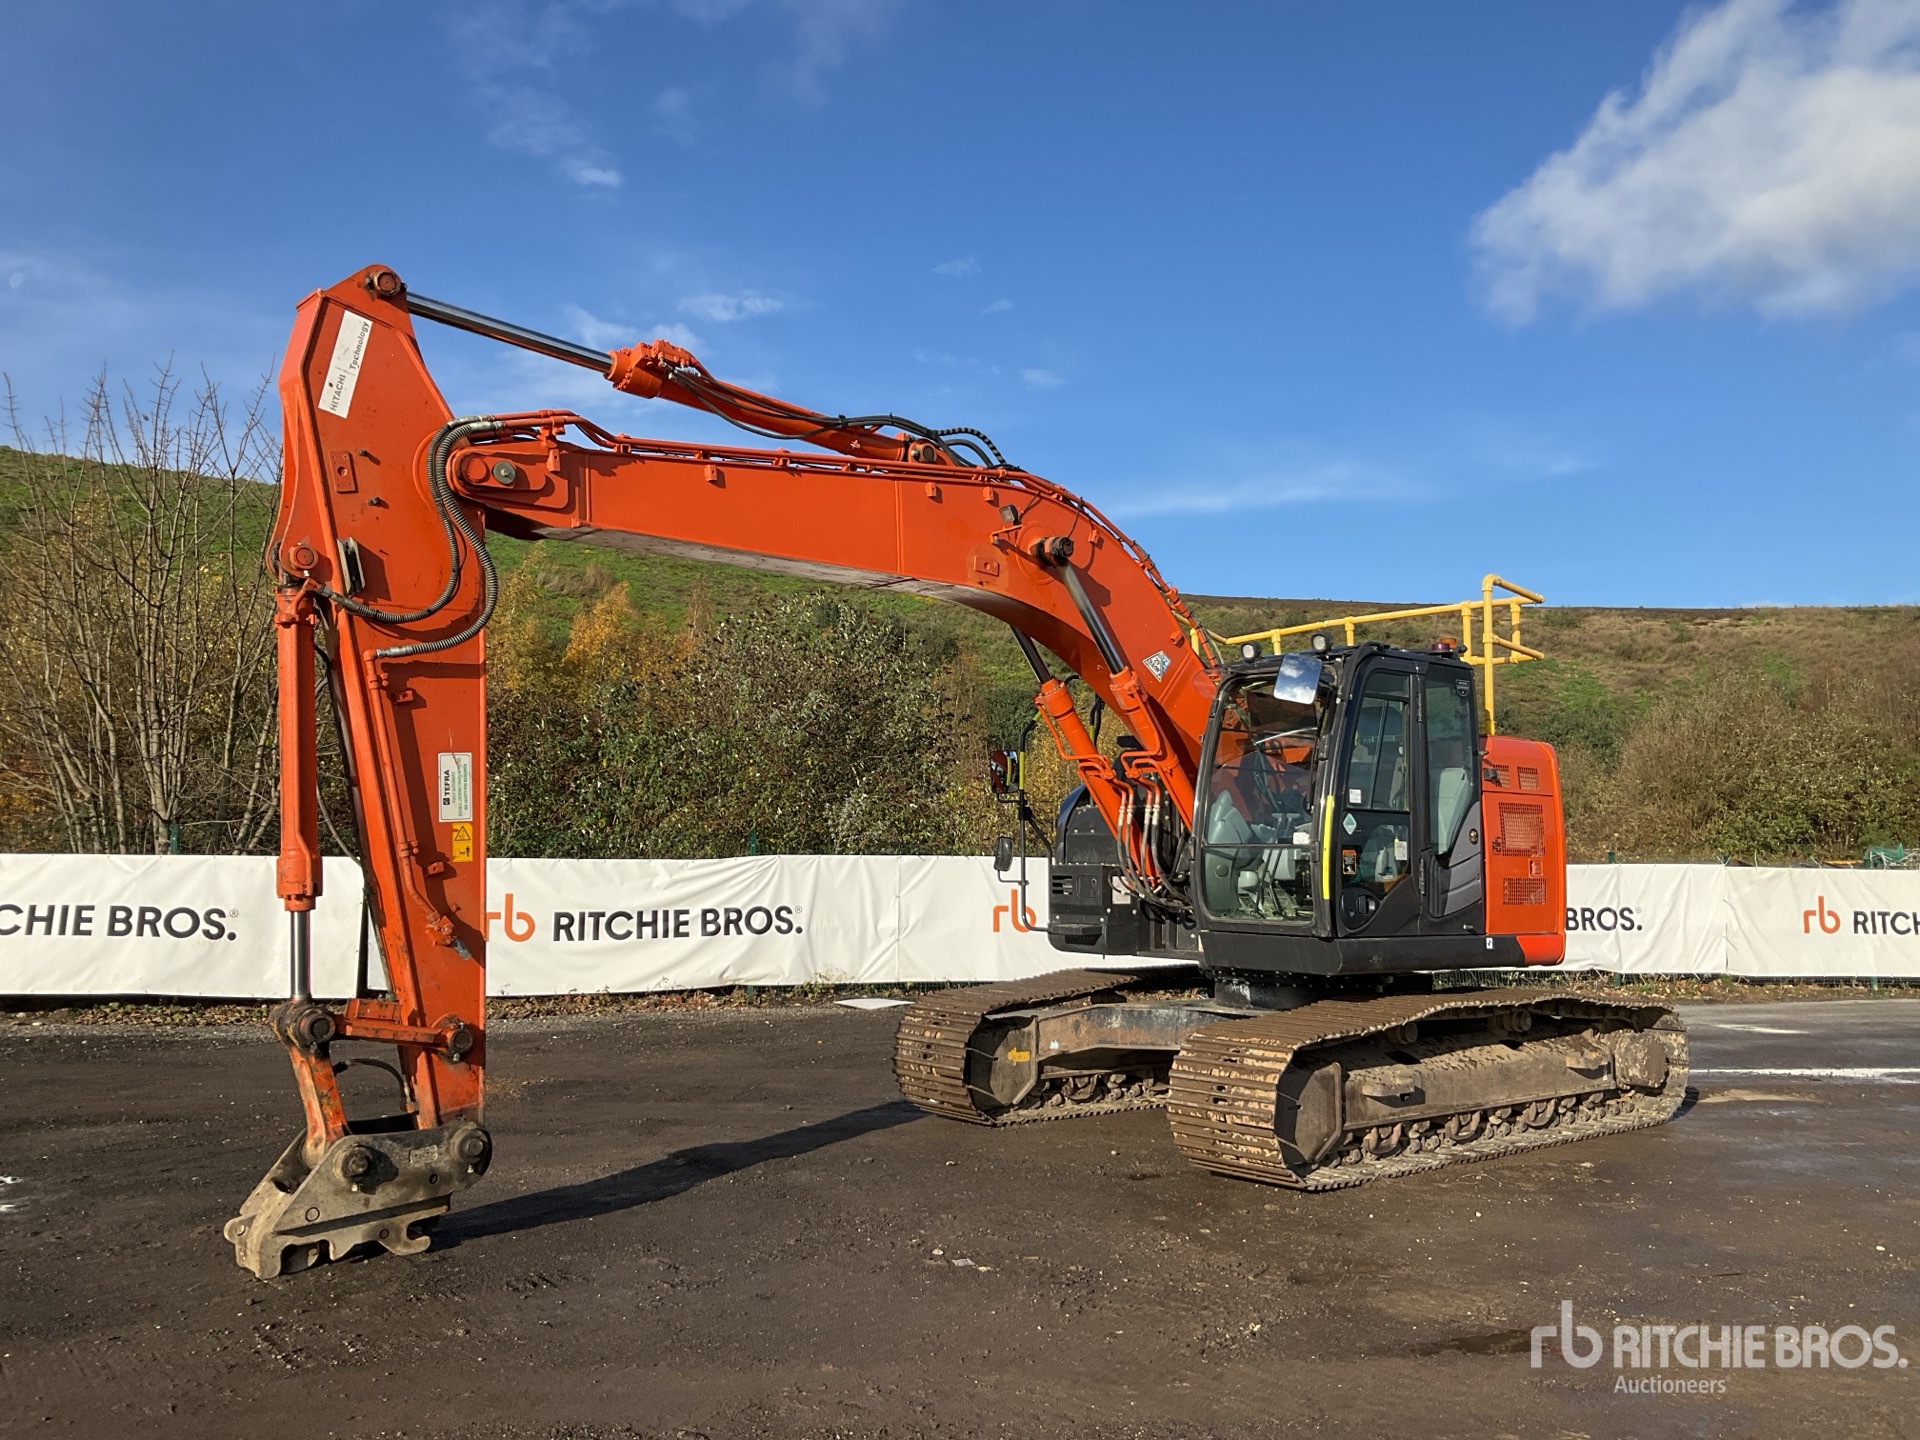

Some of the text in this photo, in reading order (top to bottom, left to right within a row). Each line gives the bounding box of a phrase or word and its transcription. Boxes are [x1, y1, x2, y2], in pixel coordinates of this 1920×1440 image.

[349, 321, 370, 371] Technology
[329, 374, 347, 411] HITACHI
[485, 893, 536, 942] rb
[553, 910, 690, 941] RITCHIE
[993, 889, 1037, 933] rb
[1803, 896, 1841, 934] rb
